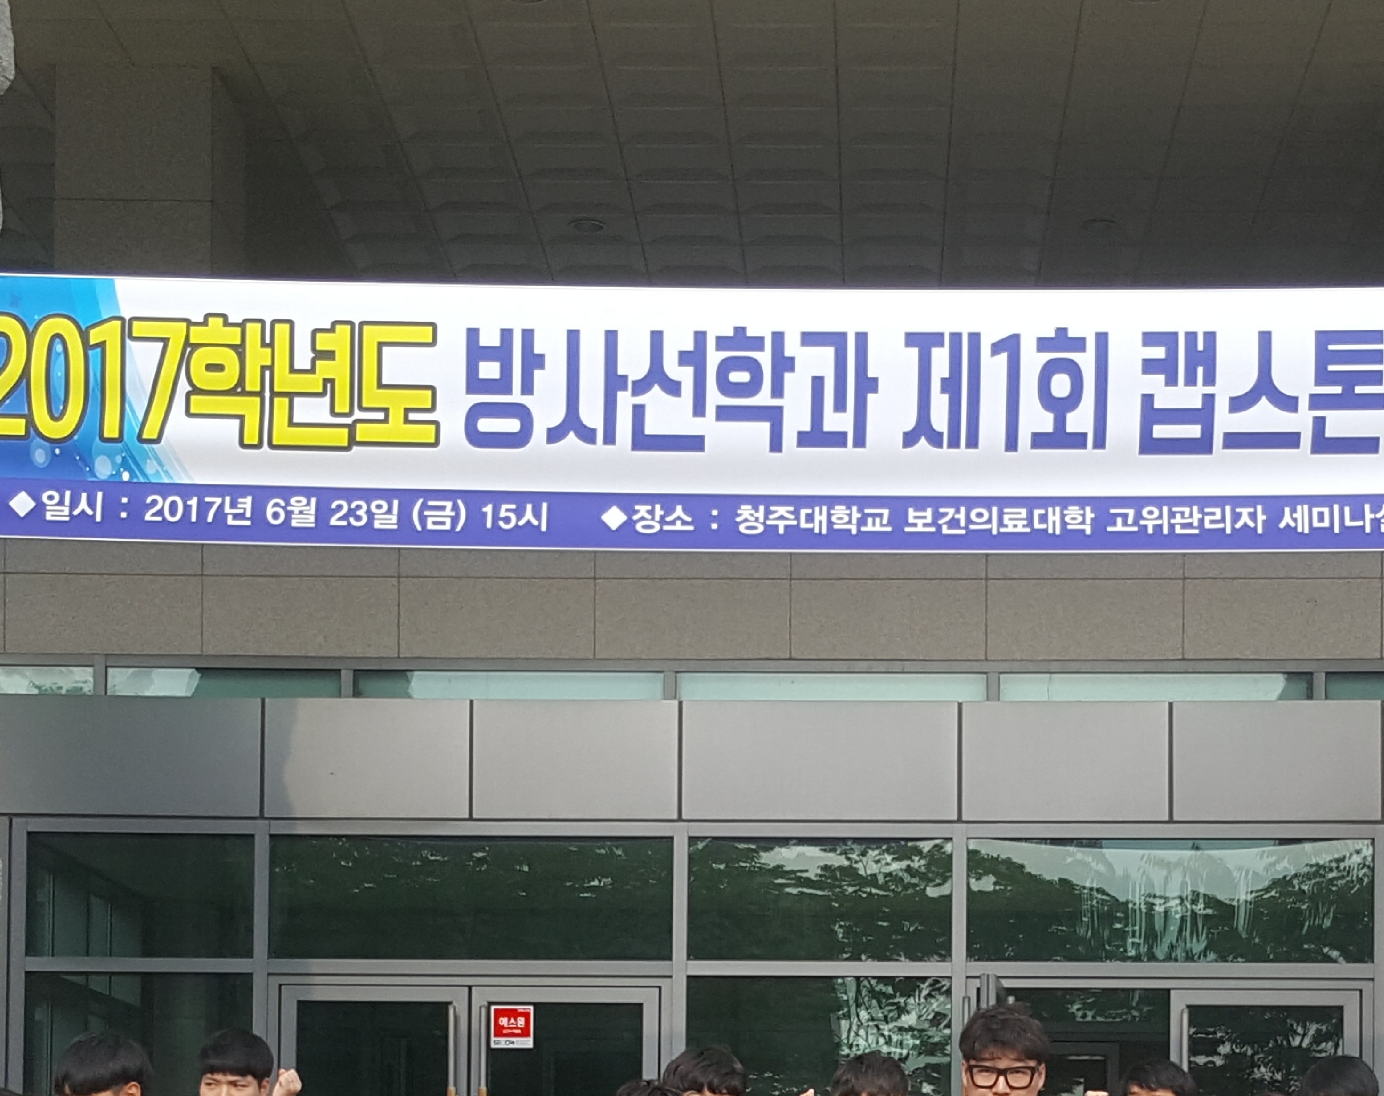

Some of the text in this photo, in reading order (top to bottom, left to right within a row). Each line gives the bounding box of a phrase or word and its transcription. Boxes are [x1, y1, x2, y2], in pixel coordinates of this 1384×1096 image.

[463, 325, 879, 453] 방사선학과
[902, 325, 1109, 453] 제1회
[41, 489, 104, 523] 일시
[143, 494, 254, 527] 2017년
[265, 495, 318, 529] 6월
[329, 498, 400, 531] 23일
[411, 497, 467, 533] (금)
[480, 501, 549, 533] 15시
[630, 503, 695, 534] 장소
[733, 504, 893, 535] 청주대학교
[903, 505, 1096, 537] 보건의료대학
[1105, 504, 1267, 536] 고위관리자
